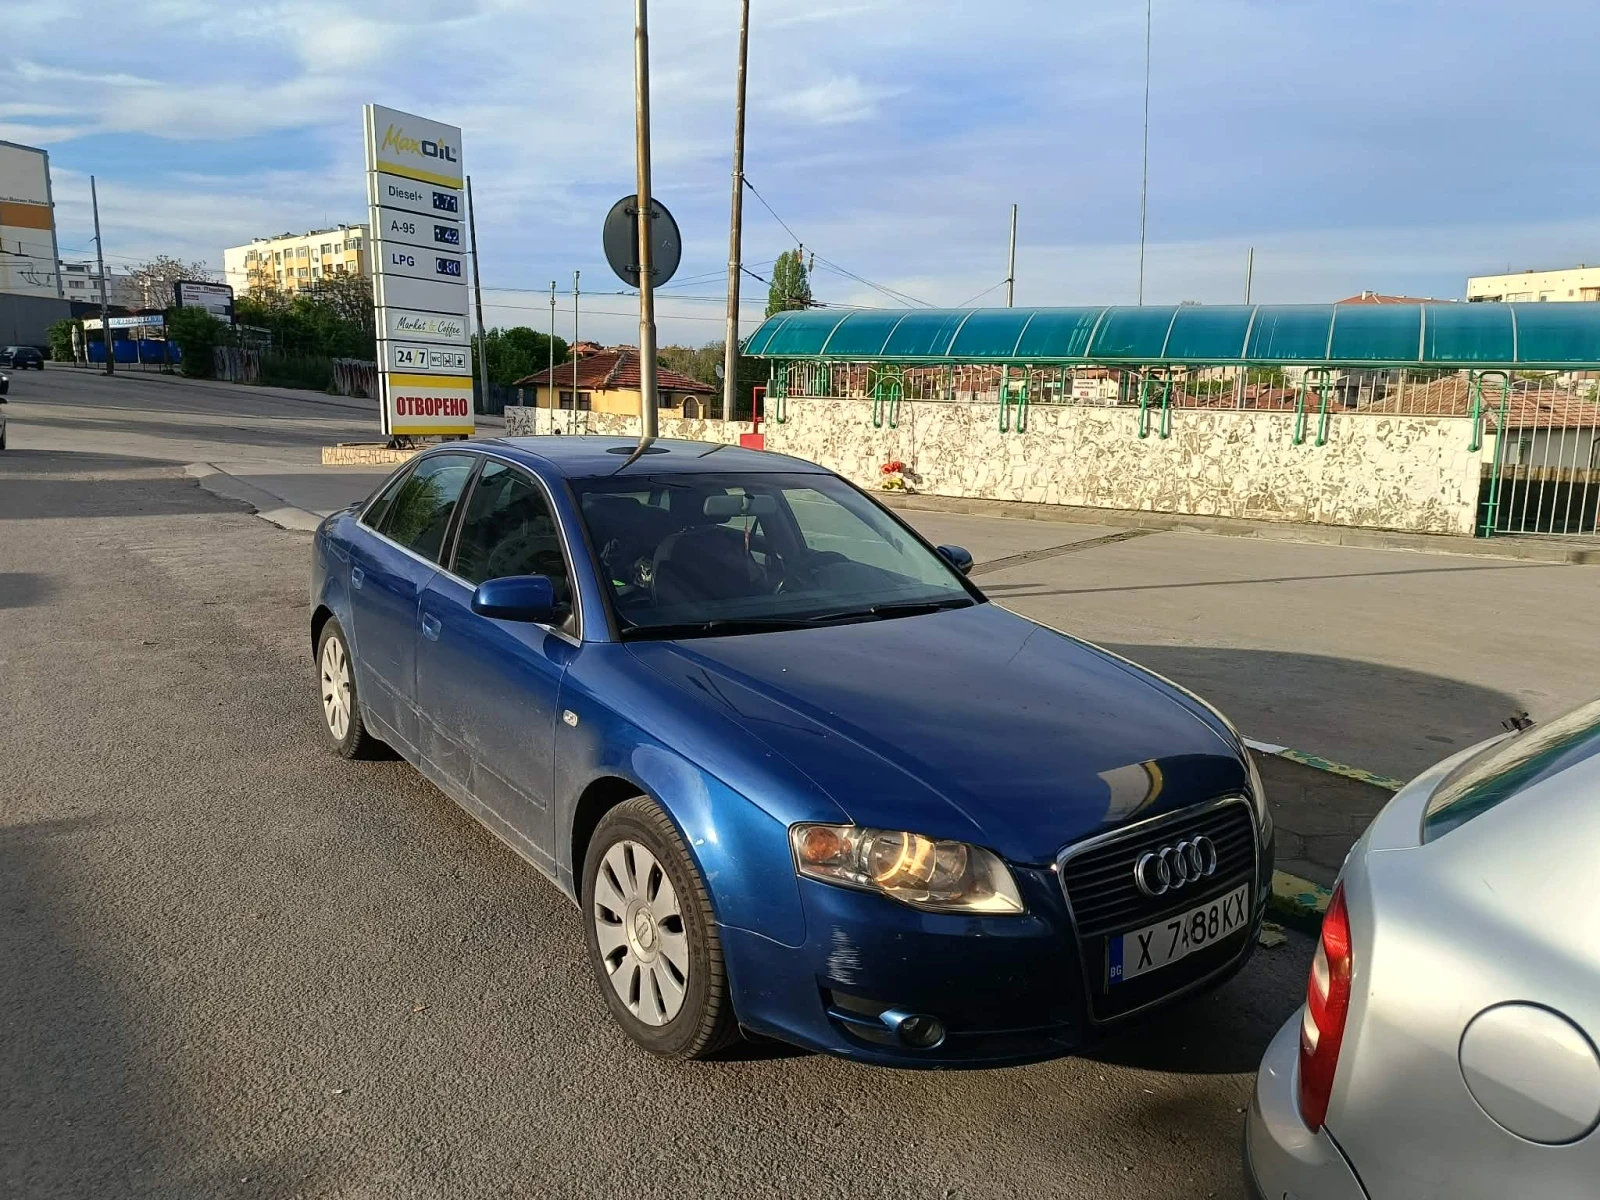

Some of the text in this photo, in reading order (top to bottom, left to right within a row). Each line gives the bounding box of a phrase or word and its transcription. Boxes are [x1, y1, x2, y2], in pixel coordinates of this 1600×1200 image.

[388, 185, 457, 211] Diesel+ 1.71
[391, 220, 416, 235] A-95
[392, 253, 460, 274] LPG 0.80
[396, 316, 426, 331] Market
[437, 320, 461, 338] Coffee
[397, 350, 426, 366] 24/7
[396, 396, 468, 417] ОТВОРЕНО
[1110, 964, 1122, 978] BG
